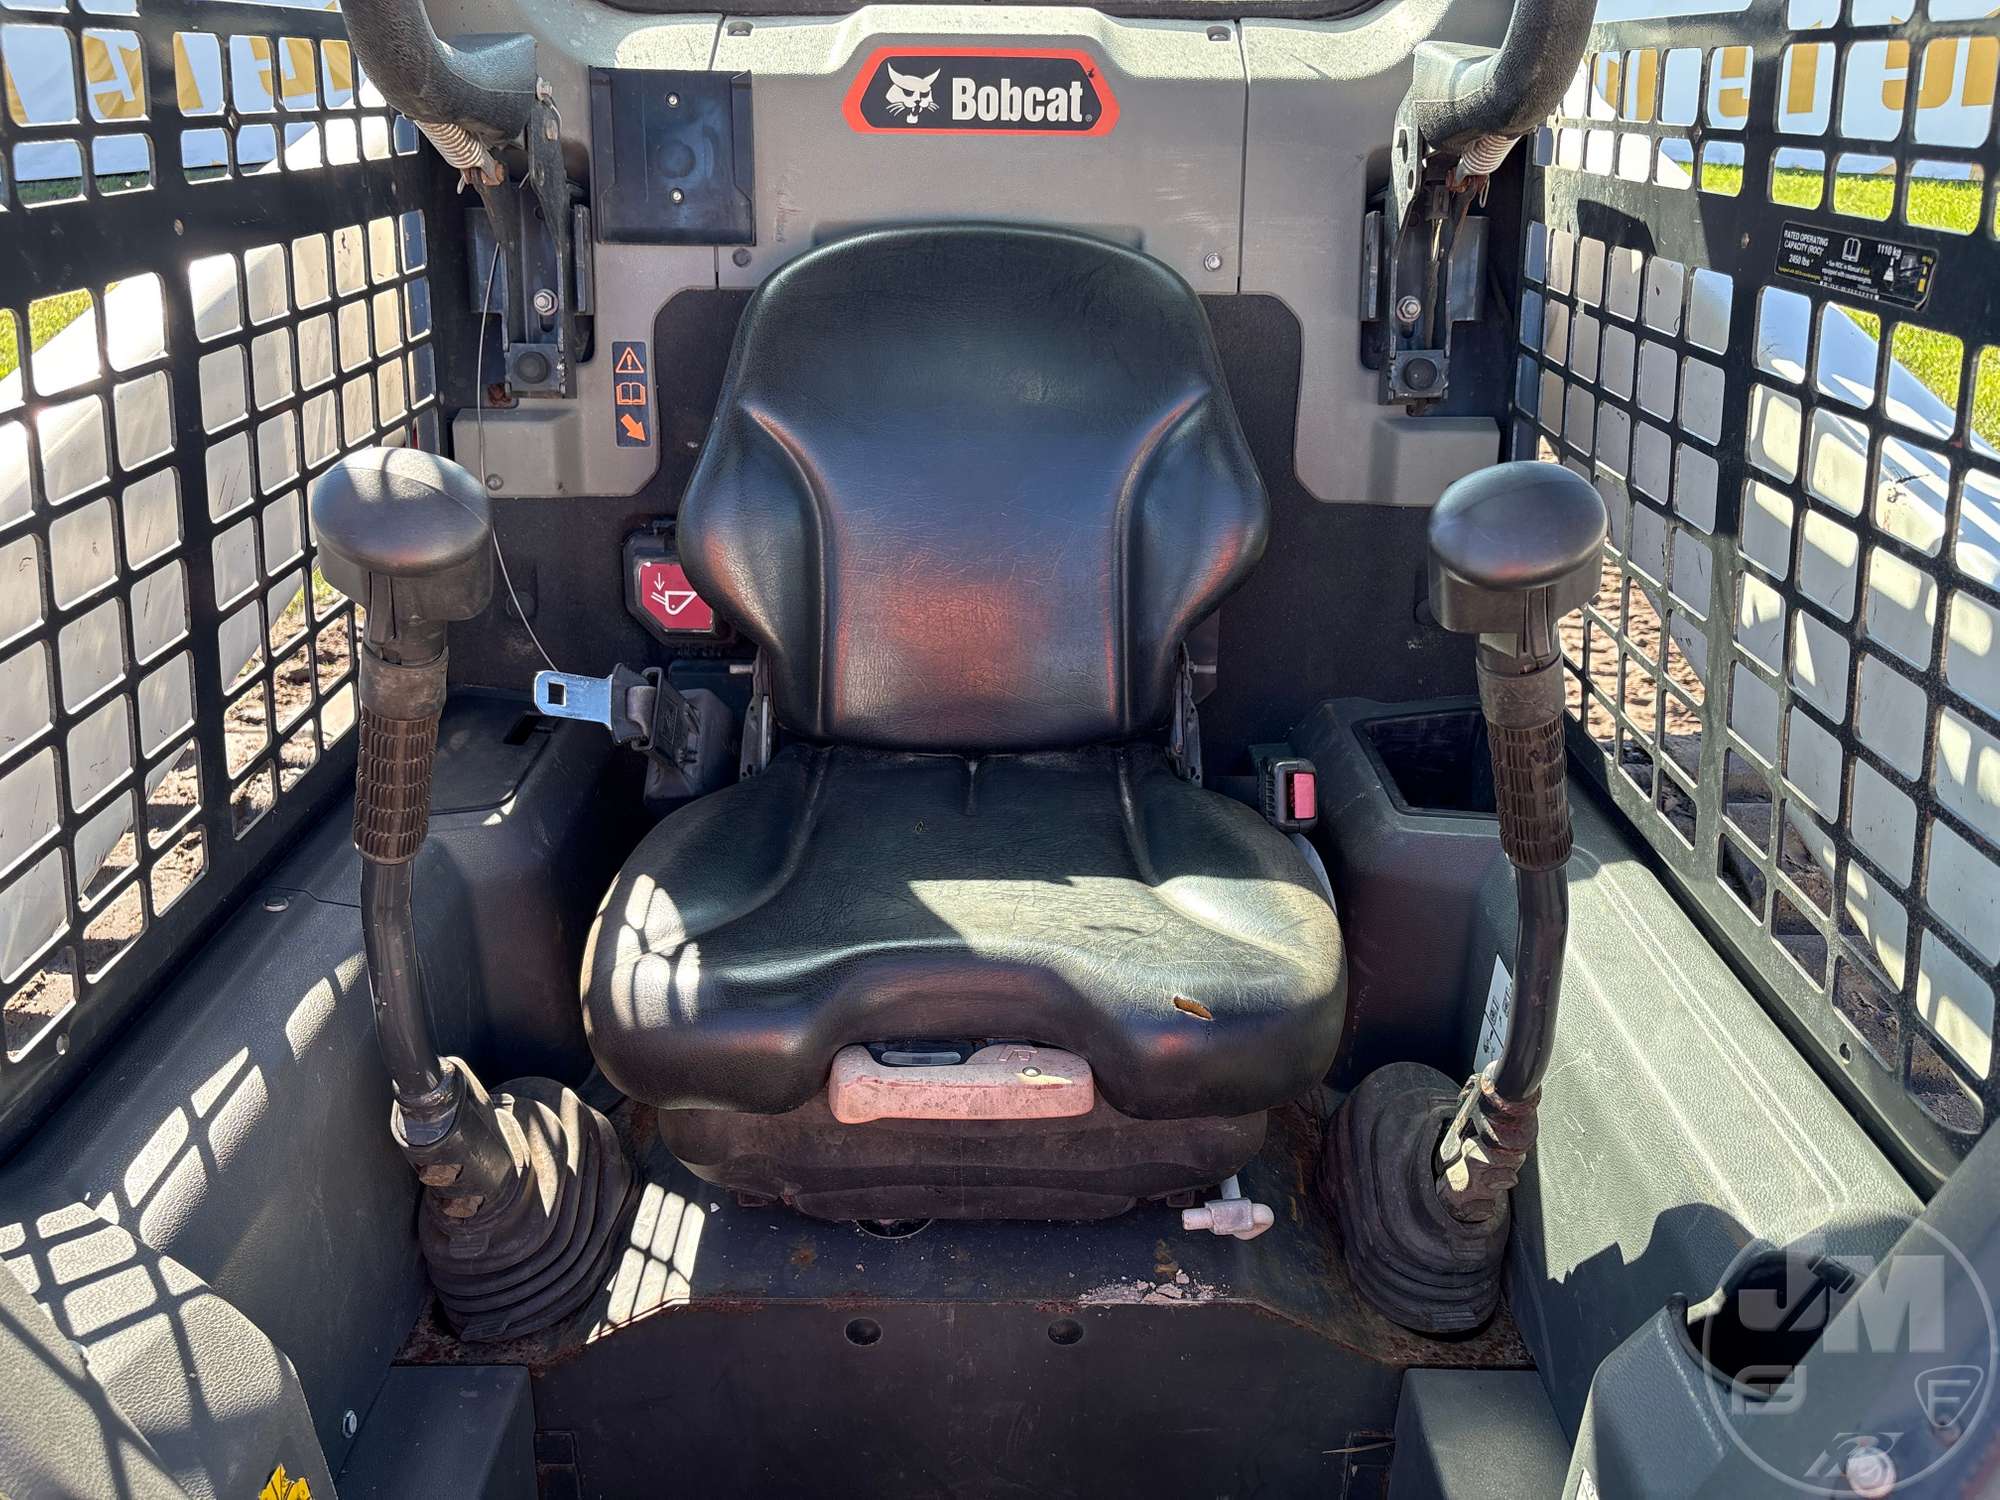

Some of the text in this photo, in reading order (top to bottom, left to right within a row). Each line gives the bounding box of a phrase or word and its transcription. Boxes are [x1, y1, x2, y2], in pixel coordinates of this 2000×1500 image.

[951, 77, 1084, 123] Bobcat
[1783, 229, 1829, 247] RATED OPERATING
[1783, 239, 1808, 252] CAPACITY
[1877, 243, 1902, 260] 1110 kg
